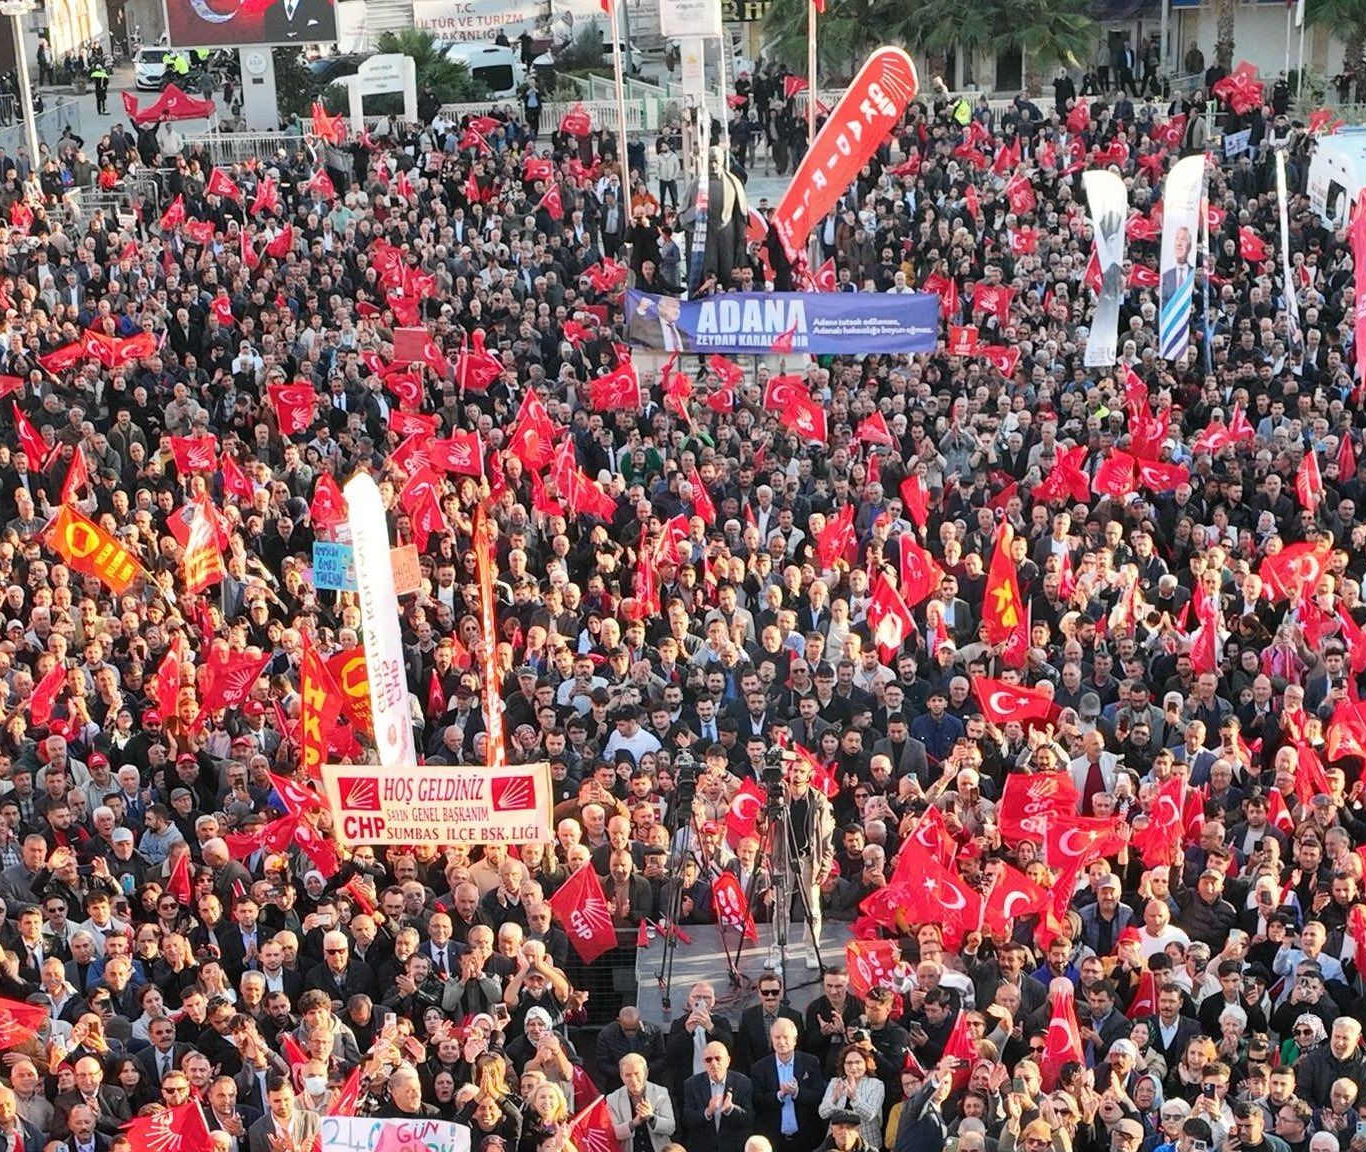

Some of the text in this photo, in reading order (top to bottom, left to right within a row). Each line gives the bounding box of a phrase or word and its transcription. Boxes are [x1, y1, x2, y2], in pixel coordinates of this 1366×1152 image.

[415, 17, 455, 29] ÜLTÜR
[696, 299, 807, 334] ADANA
[696, 334, 736, 346] ZEYDAN
[383, 774, 485, 806] HOŞ GELDİNİZ
[386, 805, 490, 824] SAYIN GENEL BAŞKANIM
[343, 815, 386, 840] CHP
[387, 827, 440, 841] SUMBAS
[446, 825, 477, 843] İLÇE
[570, 909, 593, 942] CHP
[396, 1121, 439, 1144] GÜN
